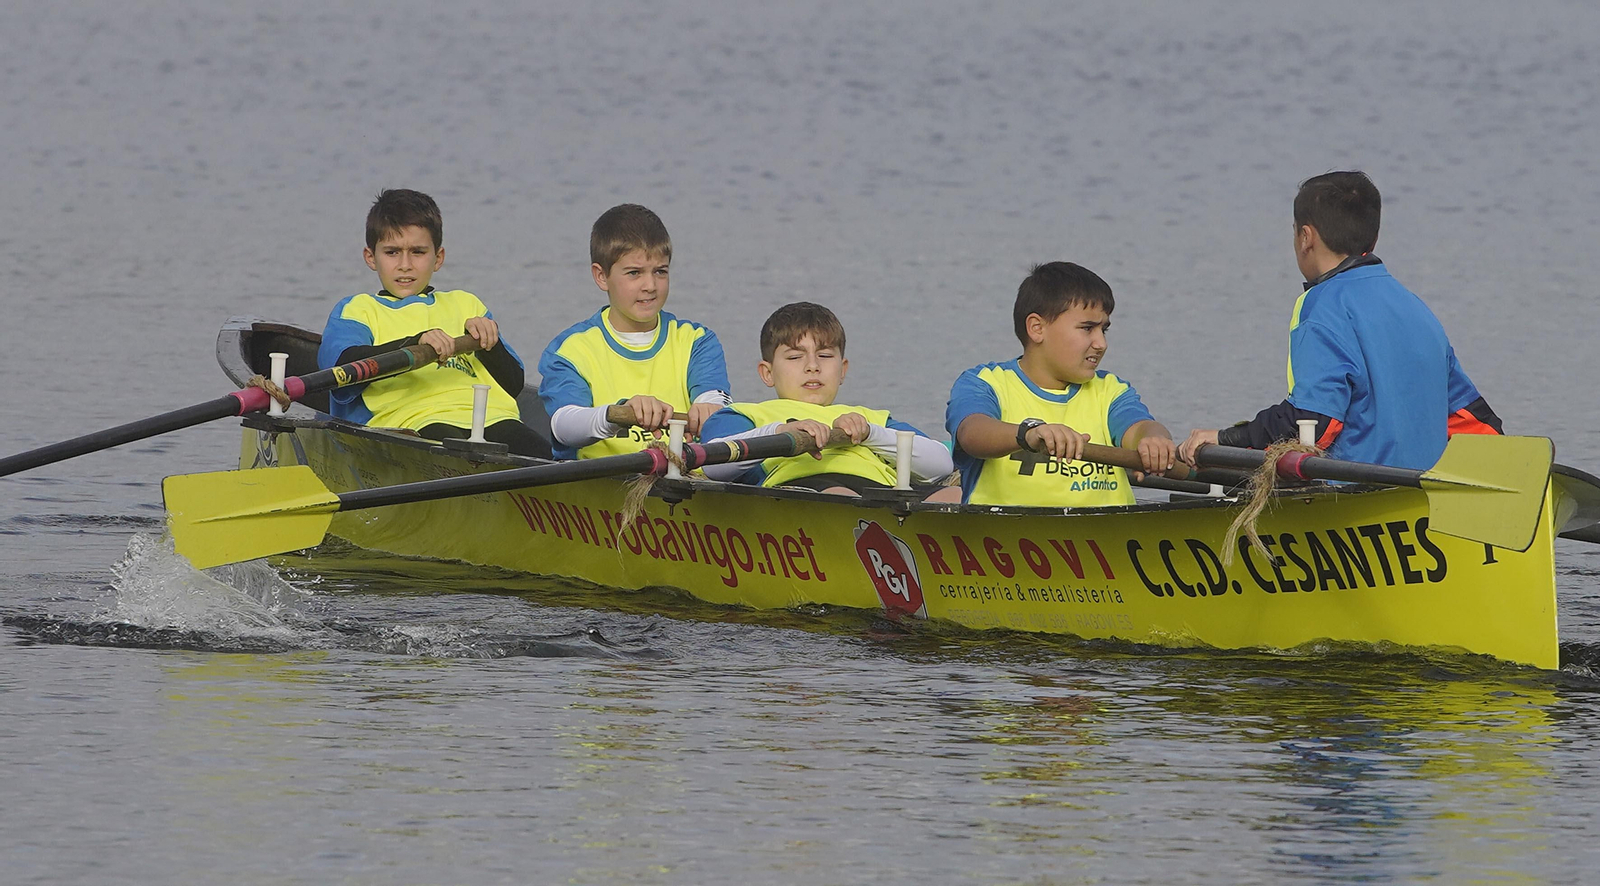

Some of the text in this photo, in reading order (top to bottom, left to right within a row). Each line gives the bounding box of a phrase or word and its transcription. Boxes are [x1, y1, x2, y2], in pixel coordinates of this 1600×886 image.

[507, 491, 827, 588] www.rodavigo.net
[916, 533, 1116, 580] RAGOVI
[1238, 516, 1448, 594] CESANTES
[867, 548, 910, 602] RGV
[1015, 583, 1027, 601] &
